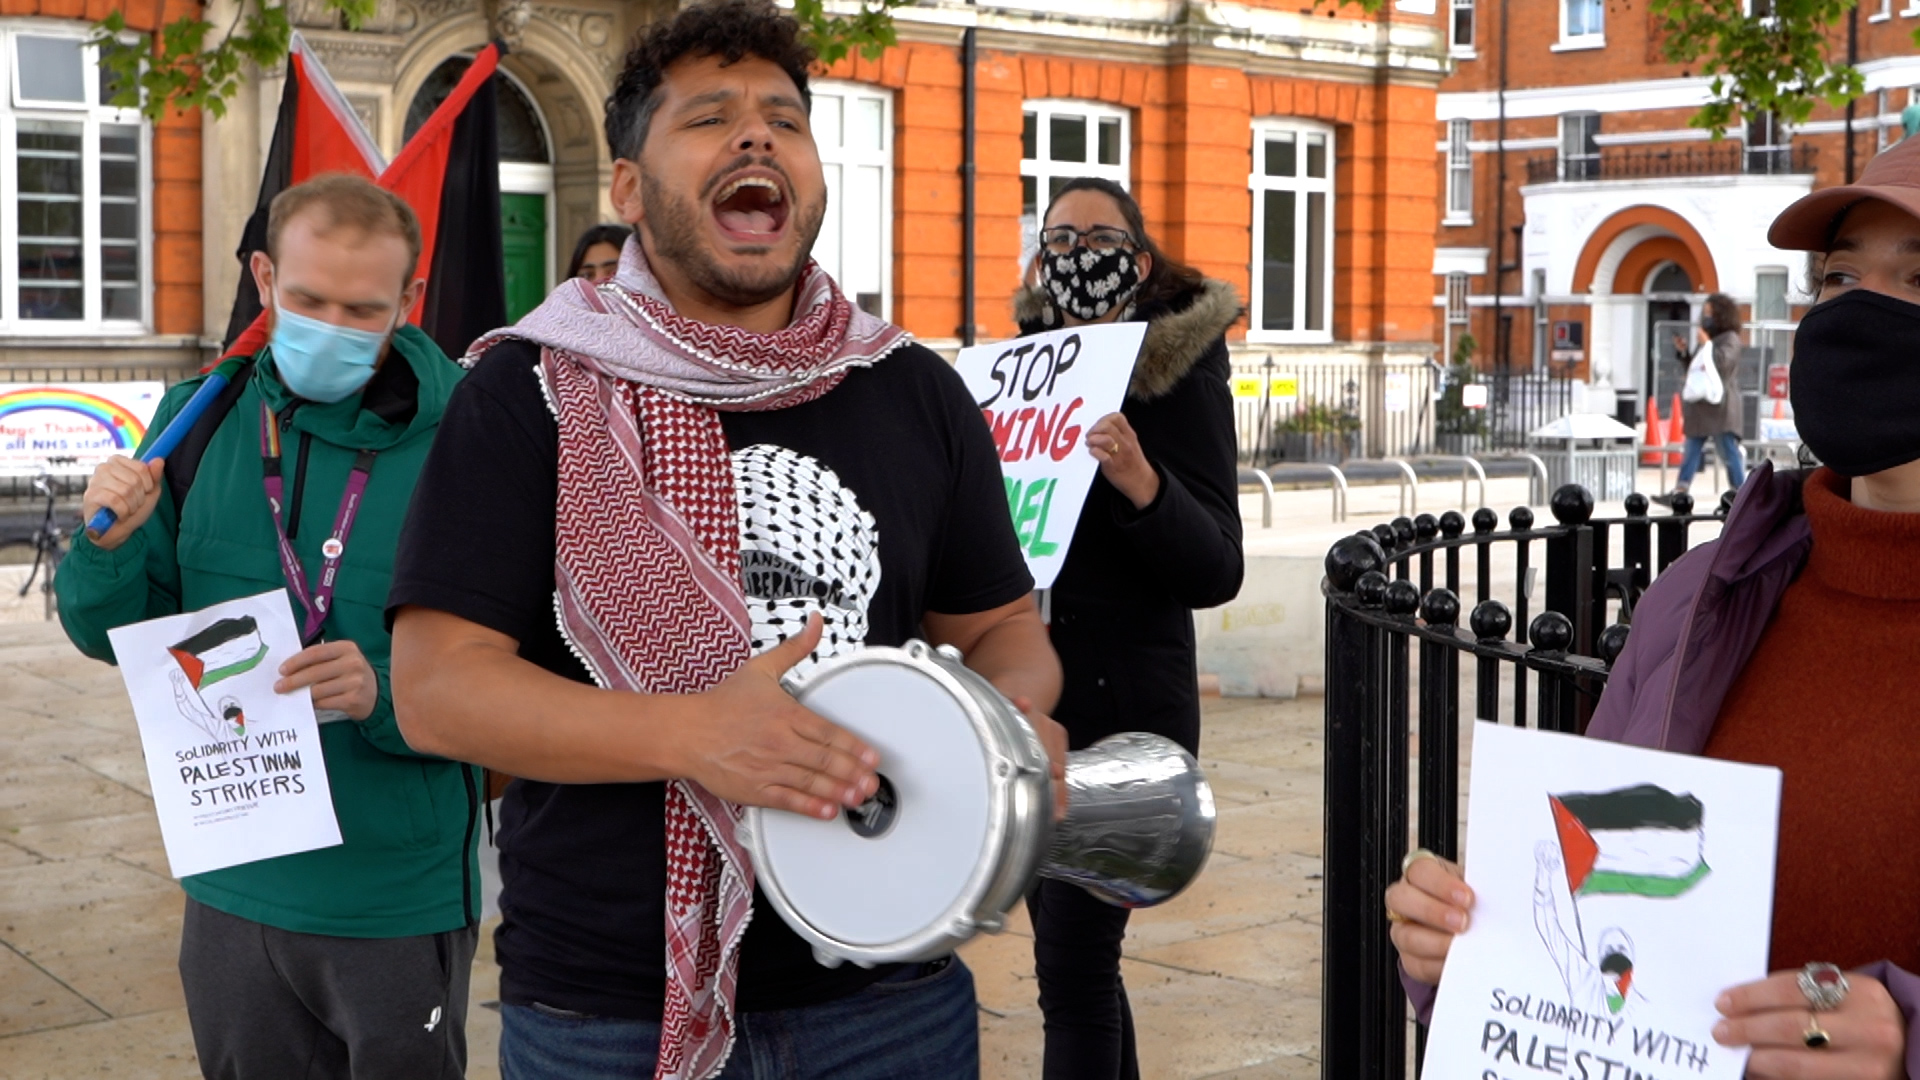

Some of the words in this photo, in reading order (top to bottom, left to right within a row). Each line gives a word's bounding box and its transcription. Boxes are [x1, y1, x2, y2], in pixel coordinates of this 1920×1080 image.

[980, 333, 1082, 409] STOP
[6, 437, 25, 450] all
[33, 439, 67, 450] NHS
[76, 438, 113, 448] staff
[744, 571, 843, 605] IBERATION
[175, 736, 249, 762] SOLIDARITY
[255, 728, 298, 748] WITH
[180, 750, 302, 785] PALESTINIAN
[190, 774, 305, 806] STRIKERS
[1491, 988, 1624, 1045] SOLIDARITY
[1633, 1026, 1710, 1074] WITH
[1481, 1020, 1654, 1080] PALEST
